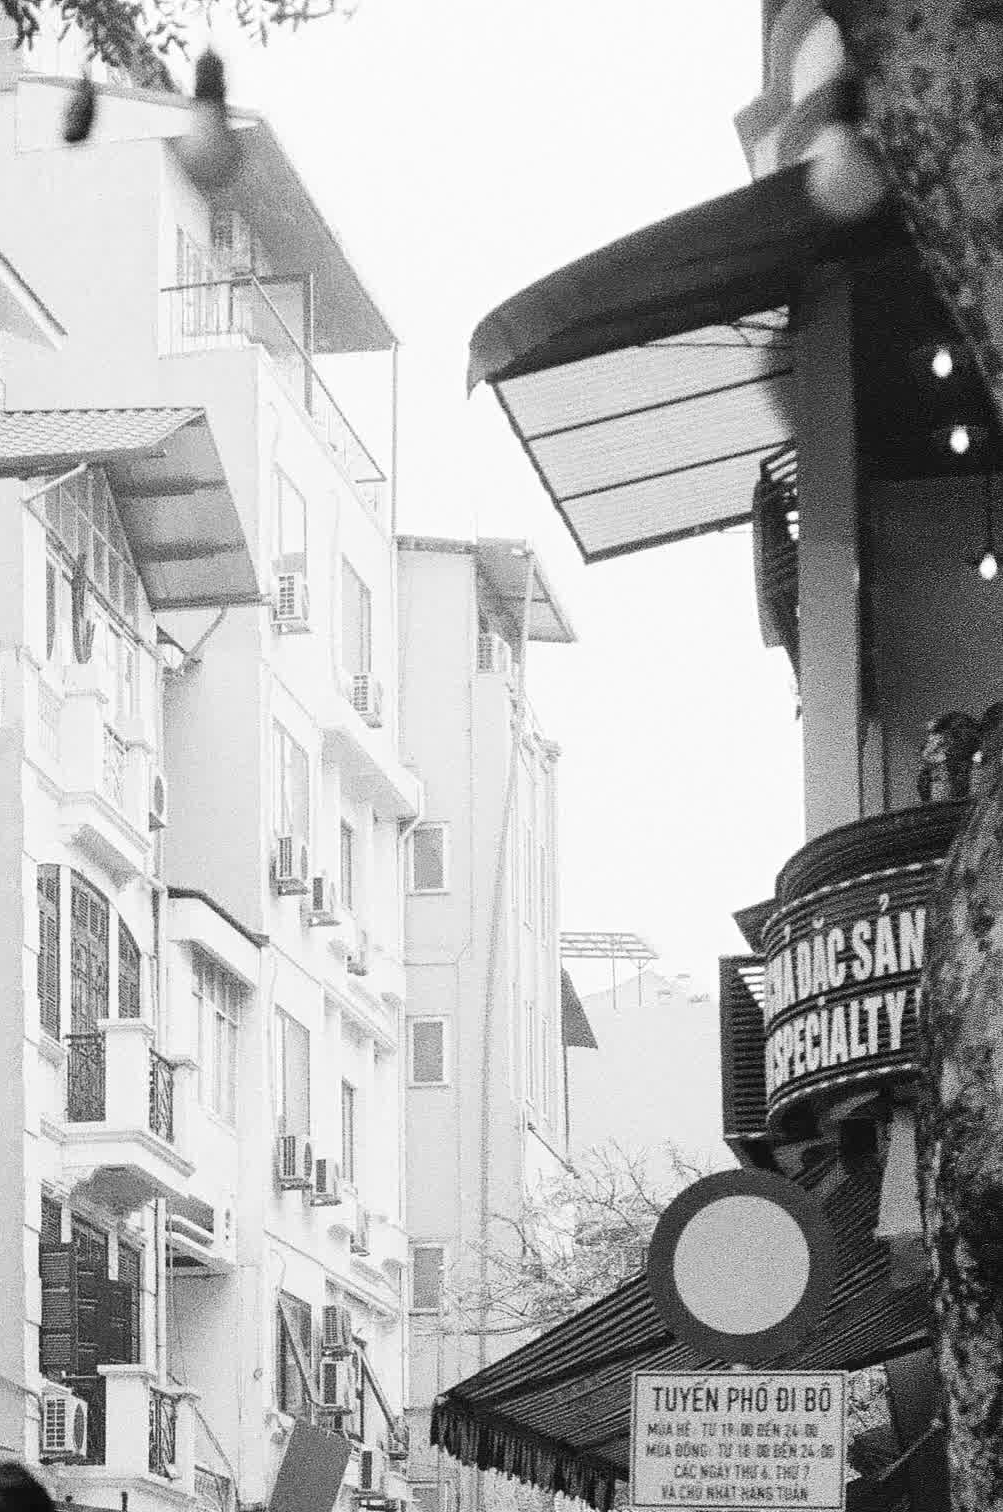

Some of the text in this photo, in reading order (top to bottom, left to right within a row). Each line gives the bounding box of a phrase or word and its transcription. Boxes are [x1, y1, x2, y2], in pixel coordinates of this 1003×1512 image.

[797, 917, 846, 1006] ĐẶC
[851, 893, 926, 981] SẢN
[652, 1378, 831, 1417] TUYẾN PHỐ ĐI BỘ
